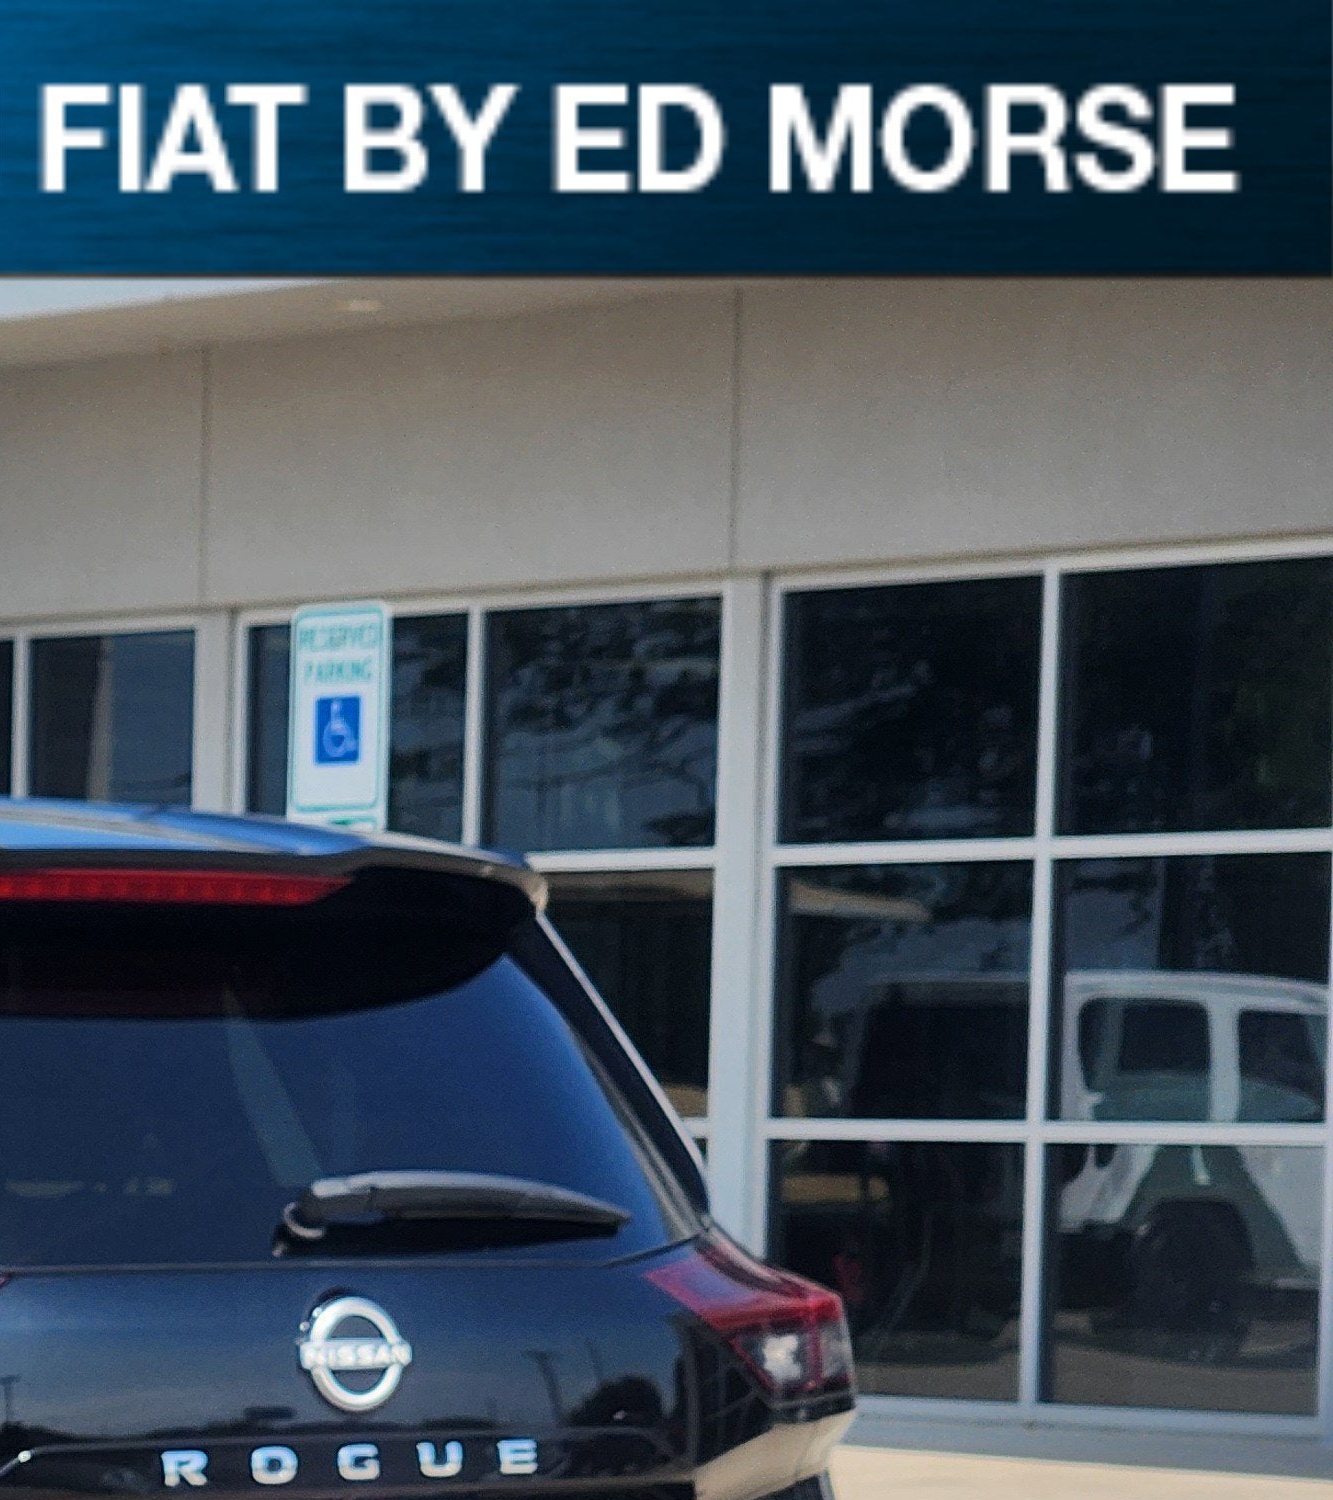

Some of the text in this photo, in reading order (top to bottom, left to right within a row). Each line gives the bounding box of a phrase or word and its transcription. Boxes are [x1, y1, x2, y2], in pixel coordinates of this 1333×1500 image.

[303, 658, 373, 685] PARKING
[304, 1344, 410, 1368] NISSAN
[159, 1437, 539, 1488] ROGUE
